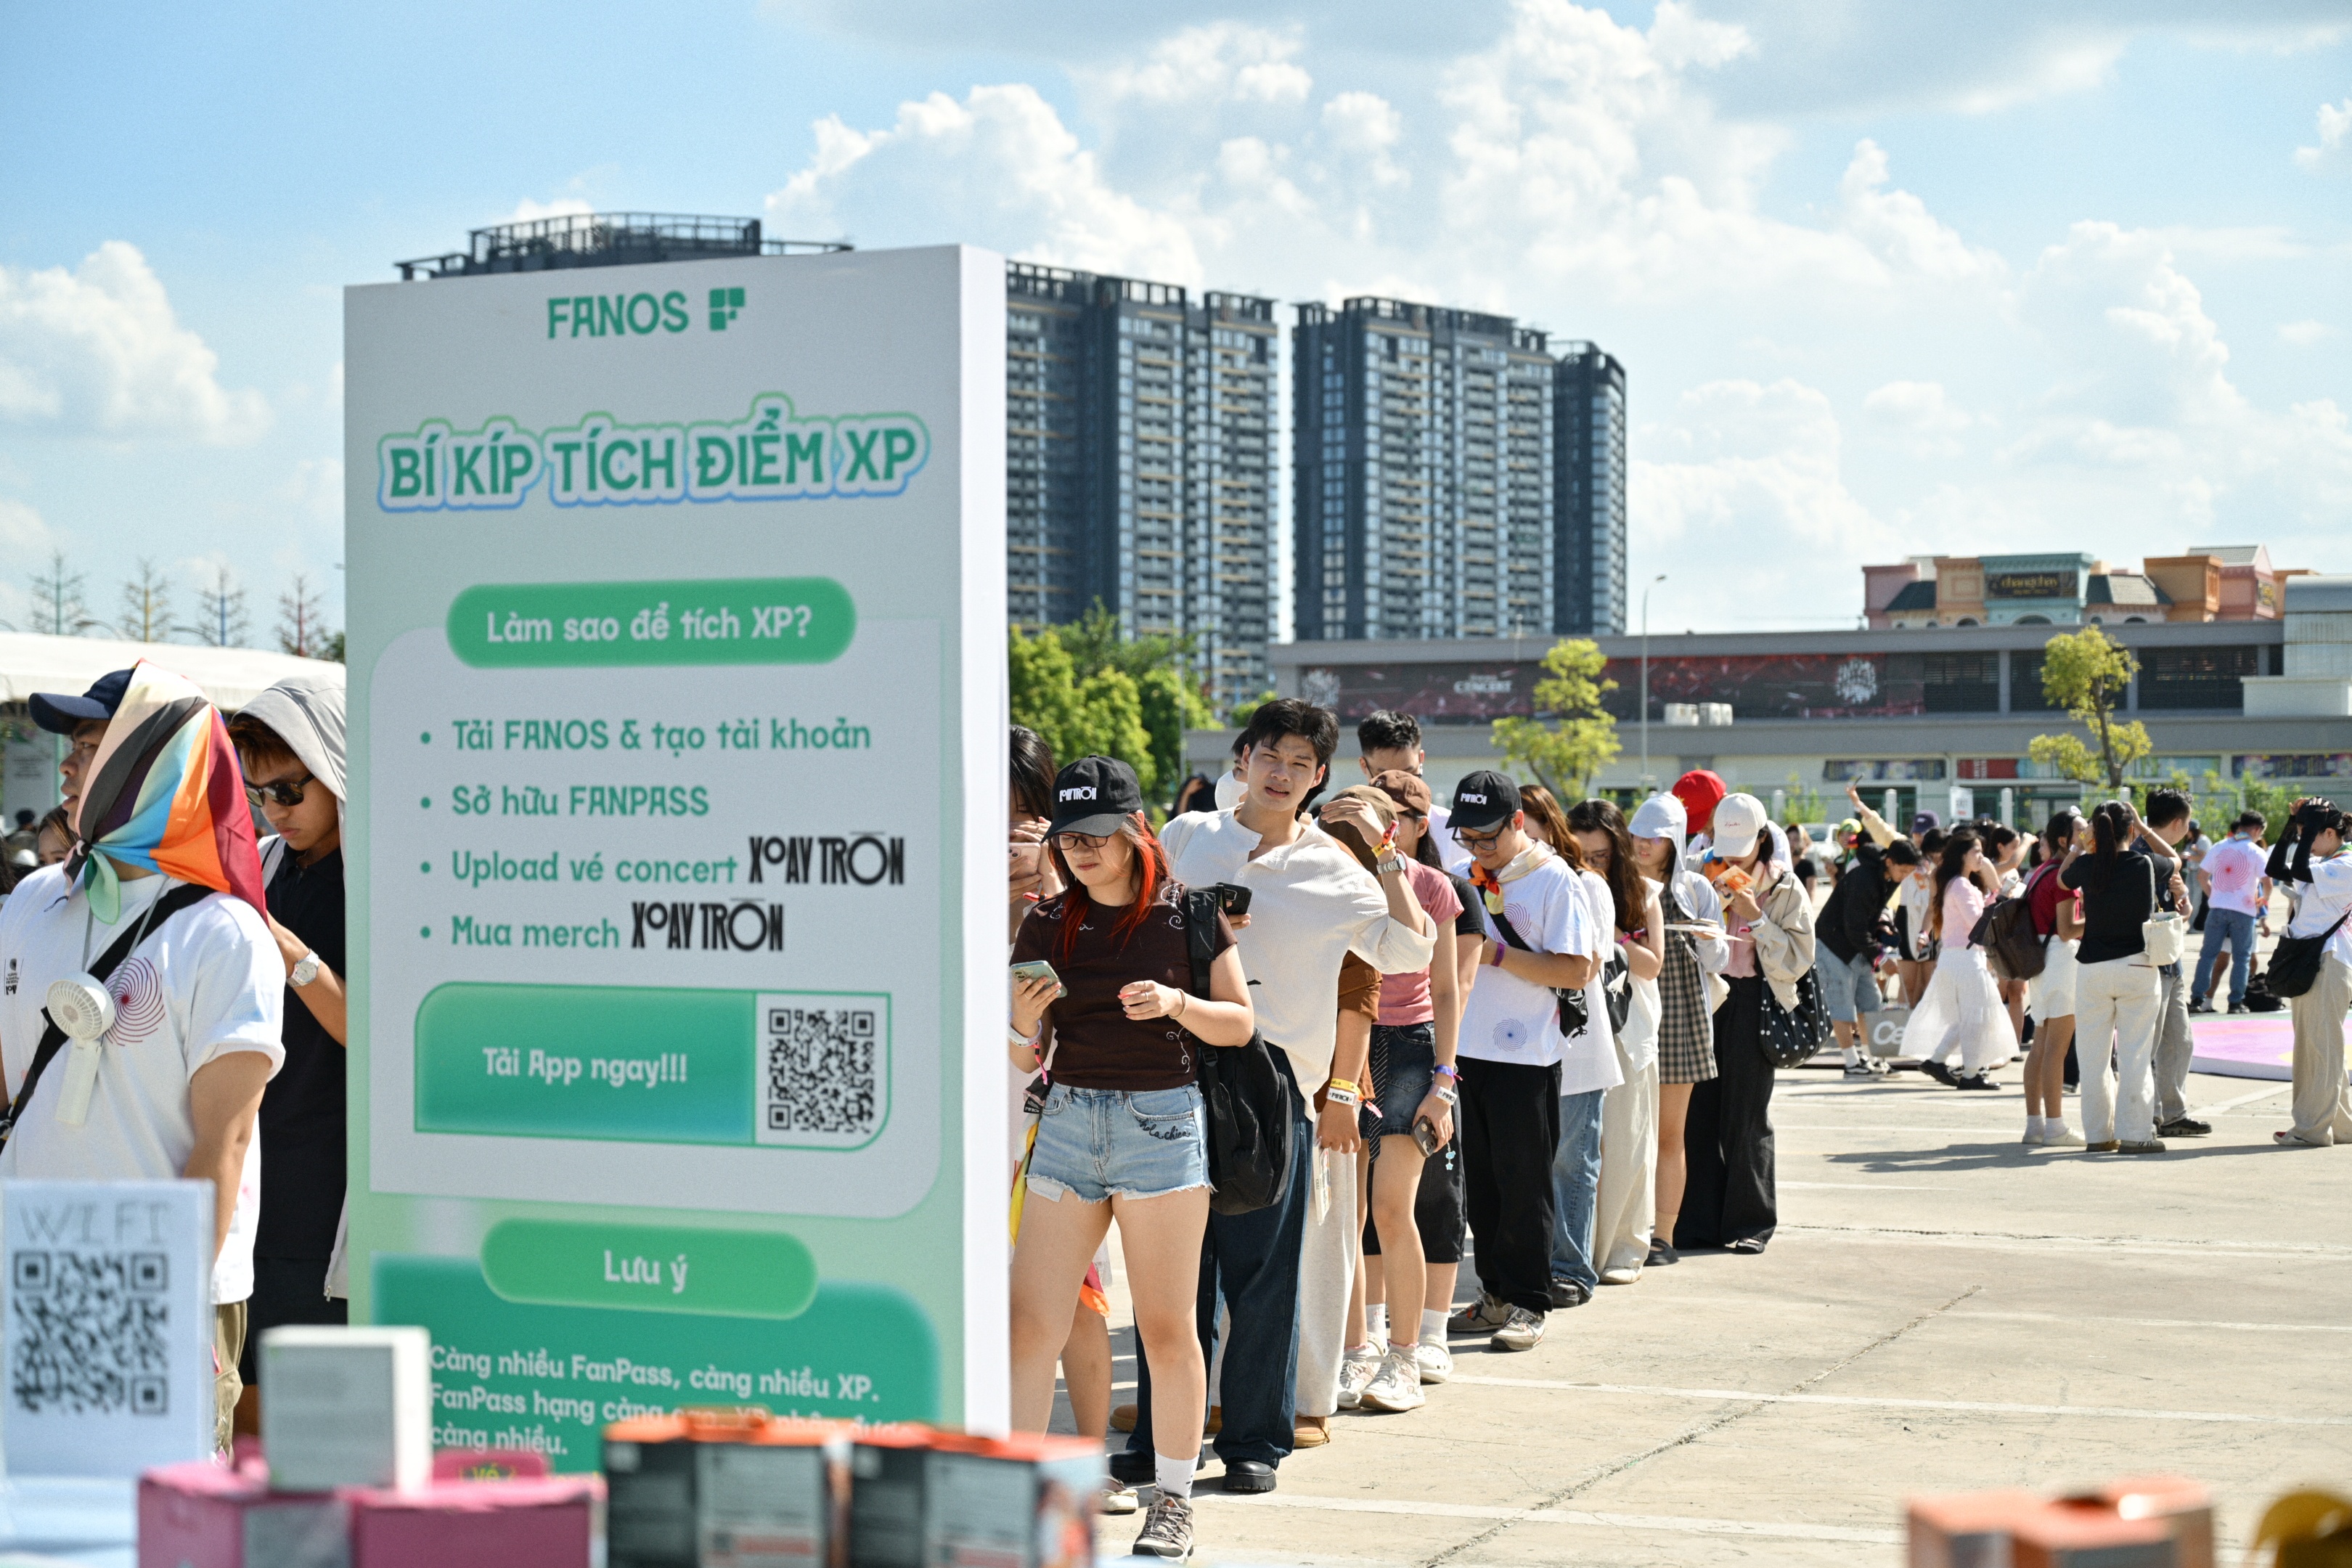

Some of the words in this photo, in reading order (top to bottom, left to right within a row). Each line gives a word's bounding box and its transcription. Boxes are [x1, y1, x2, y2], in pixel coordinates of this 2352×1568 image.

[548, 291, 689, 338] FANOS
[390, 433, 440, 497] BÍ
[454, 433, 534, 496] KÍP
[552, 427, 676, 492] TÍCH
[695, 407, 825, 487] ĐIỂM
[845, 428, 917, 482] XP
[488, 612, 552, 642] Làm
[563, 616, 619, 641] sao
[630, 602, 669, 640] để
[680, 607, 739, 640] tích
[751, 605, 812, 638] XP?
[453, 719, 494, 750] Tải
[505, 720, 608, 750] FANOS
[620, 720, 641, 750] &
[652, 722, 706, 757] tạo
[718, 719, 760, 750] tài
[770, 717, 870, 750] khoản
[452, 785, 491, 815] Sở
[502, 785, 558, 815] hữu
[569, 785, 709, 816] FANPASS
[452, 851, 559, 887] Upload
[571, 852, 603, 883] vé
[616, 856, 738, 883] concert
[452, 916, 511, 946] Mua
[523, 918, 620, 948] merch
[483, 1048, 519, 1077] Tải
[528, 1049, 581, 1085] App
[591, 1054, 687, 1087] ngay!!!
[605, 1251, 661, 1284] Lưu
[671, 1254, 688, 1293] ý
[428, 1346, 491, 1379] Càng
[498, 1347, 564, 1378] nhiều
[572, 1355, 681, 1389] FanPass,
[690, 1365, 752, 1398] càng
[759, 1365, 830, 1398] nhiều
[838, 1373, 880, 1402] XP.
[534, 1389, 595, 1425] hạng
